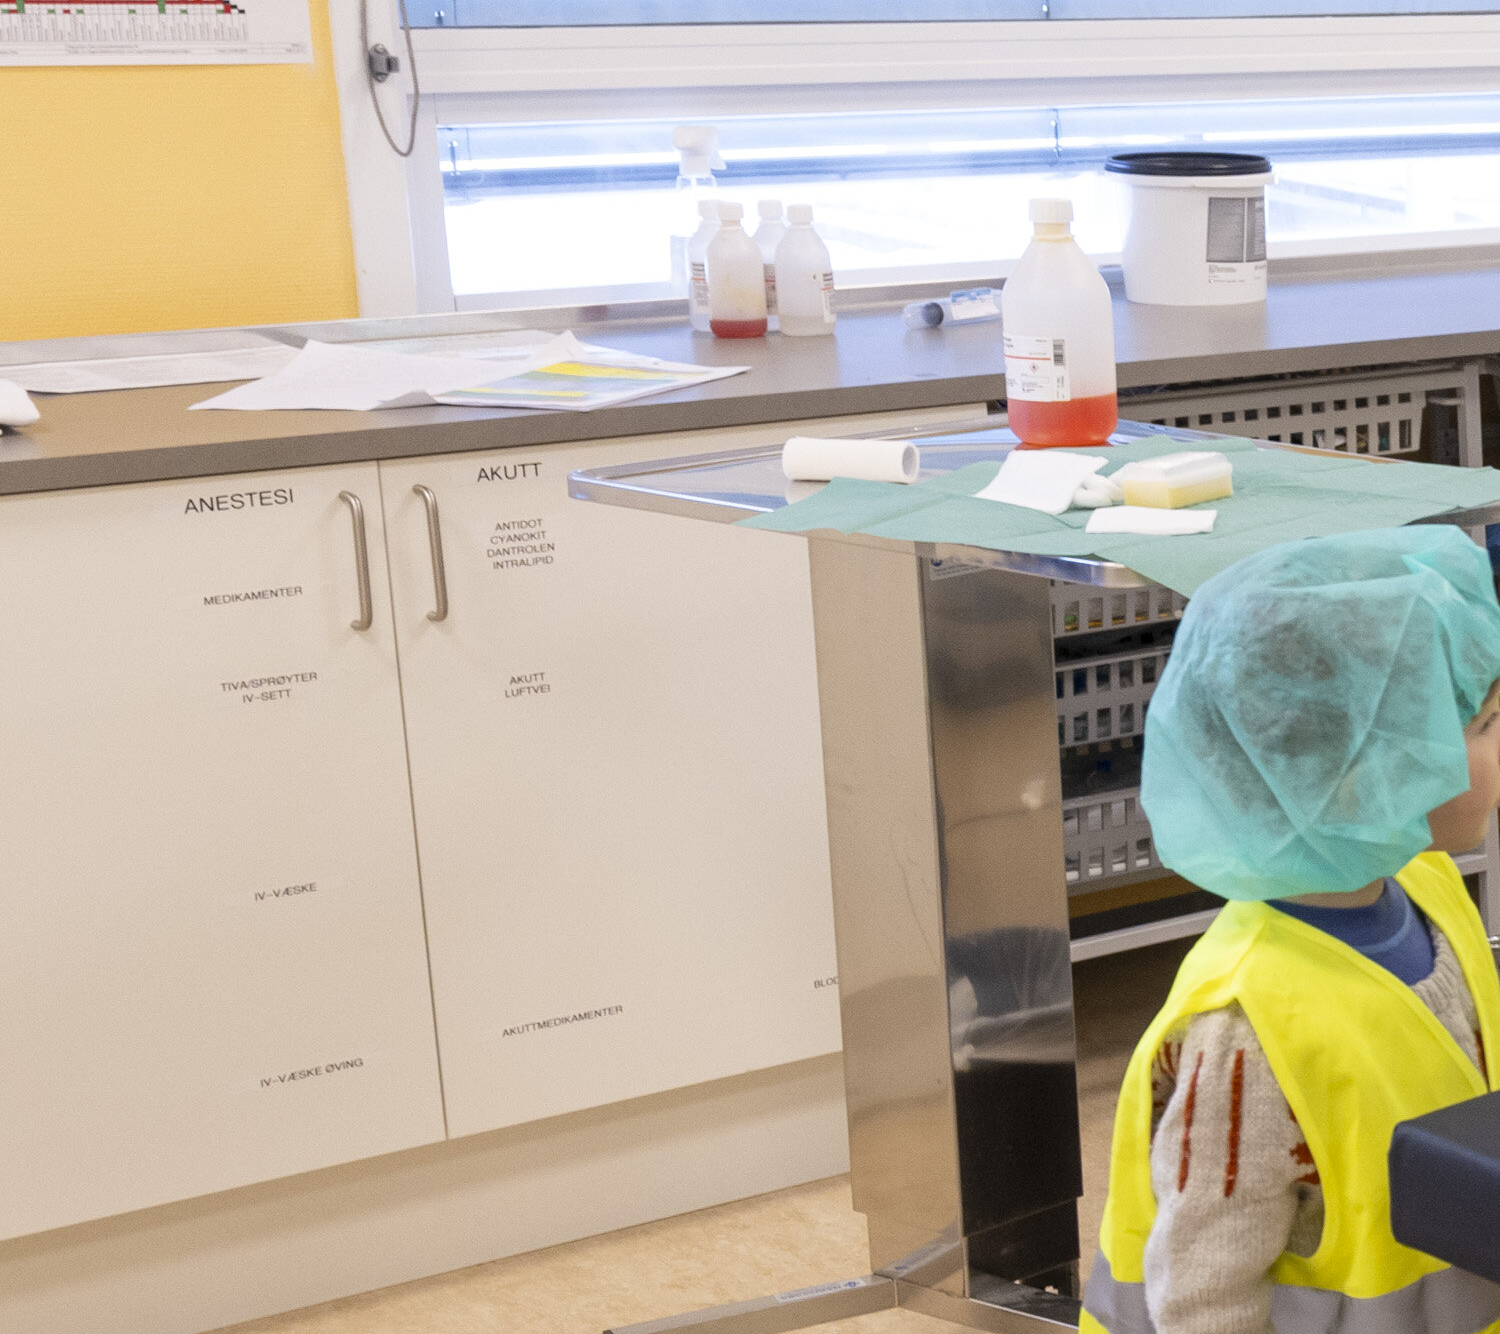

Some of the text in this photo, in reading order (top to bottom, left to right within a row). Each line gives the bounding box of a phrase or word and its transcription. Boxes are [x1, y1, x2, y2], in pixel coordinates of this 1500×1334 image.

[477, 462, 543, 483] AKUTT
[184, 488, 294, 515] ANESTESI
[495, 519, 544, 531] ANTIDOT
[490, 531, 547, 544] CYANOKIT
[486, 543, 555, 558] DANTROLEN
[492, 556, 554, 570] INTRALIPID
[203, 586, 303, 606] MEDIKAMENTER
[220, 672, 318, 692] TIVA/SPRØYTER
[509, 673, 546, 685] AKUTT
[505, 684, 551, 699] LUFTVEI
[501, 1004, 624, 1039] AKUTTMEDIKAMENTER
[324, 1057, 364, 1075] ØVING
